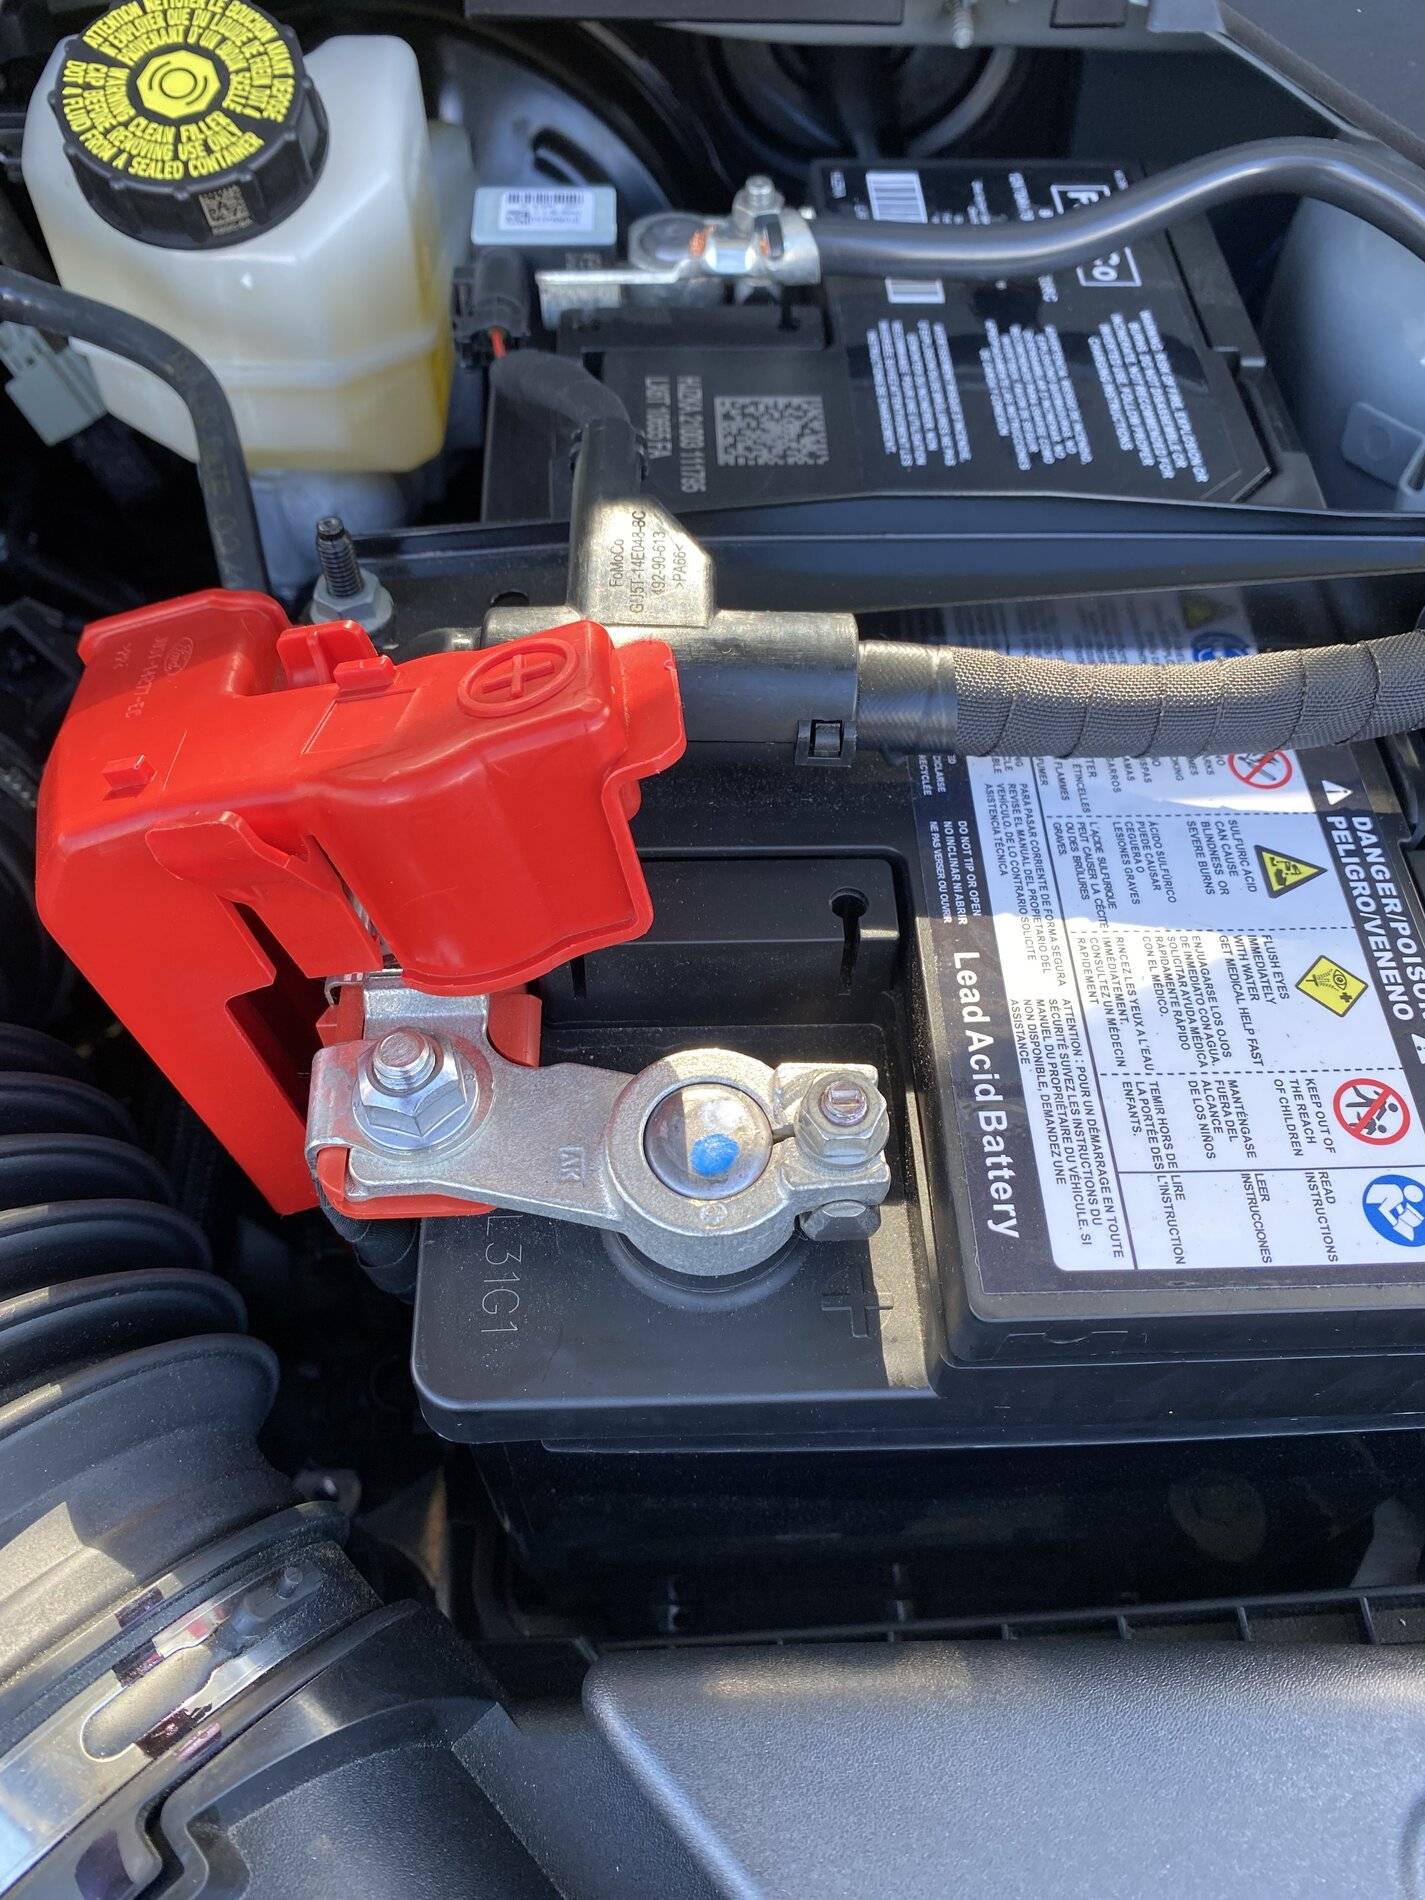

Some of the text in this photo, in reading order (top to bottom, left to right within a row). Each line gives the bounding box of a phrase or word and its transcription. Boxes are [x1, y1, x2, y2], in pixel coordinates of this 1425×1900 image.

[62, 60, 265, 180] DOT 4 FLUID FROM A SEALED CONTAINER
[83, 63, 244, 161] CAP BEFORE REMOVING USE ONLY
[104, 66, 230, 143] WARNING CLEAN FILLER
[609, 538, 624, 587] FoMoCo
[652, 531, 666, 595] 492-90-613
[1053, 761, 1070, 800] FLAMMES
[942, 820, 968, 925] NO INCLINAR NI ABRIR
[956, 820, 982, 916] DO NOT TIP OR OPEN
[1112, 821, 1141, 905] LESIONES GRAVES
[1123, 821, 1143, 864] CEGUERA
[1135, 820, 1161, 890] PUEDE CAUSAR
[1185, 820, 1216, 894] SEVERE BURNS
[1199, 821, 1230, 895] BLINDNESS OR
[1213, 820, 1239, 877] CAN CAUSE
[1227, 819, 1258, 892] SULFURIC ACID
[1114, 936, 1131, 973] RINCEZ
[1326, 815, 1414, 1021] PELIGRO/VENENO
[1075, 937, 1099, 1005] RAPIDEMENT
[1088, 937, 1127, 1067] CONSULTEZ UN MÉDECIN
[1100, 936, 1131, 1024] IMMÉDIATEMENT.
[1123, 976, 1137, 996] LES
[1141, 935, 1171, 1017] CON EL MÉDICO.
[1166, 935, 1211, 1068] SOLICITAR AYUDA MÉDICA
[1178, 935, 1221, 1066] DE INMEDIATO CON AGUA.
[1191, 935, 1232, 1057] ENJUAGARSE LOS OJOS
[1217, 934, 1264, 1066] GET MEDICAL HELP FAST
[1231, 934, 1261, 1001] WITH WATER
[1246, 934, 1277, 1004] IMMEDIATELY
[1261, 934, 1290, 999] FLUSH EYES
[1009, 998, 1030, 1064] ASSISTANCE
[1034, 998, 1053, 1041] MANUEL
[1128, 998, 1144, 1026] YEUX
[1043, 1044, 1056, 1059] DU
[1137, 1038, 1155, 1071] L'EAU
[952, 951, 1026, 1239] Lead Acid Battery
[1022, 998, 1066, 1184] NON DISPONIBLE, DEMANDEZ UNE
[1046, 1061, 1074, 1143] PROPRIÉTAIRE
[1047, 998, 1103, 1225] SÉCURITÉ SUIVEZ LES INSTRUCTIONS DU
[1061, 998, 1124, 1258] ATTENTION POUR UN DÉMARRAGE EN TOUTE
[1121, 1081, 1143, 1136] ENFANTS.
[1134, 1080, 1165, 1170] LA PORTÉE DES
[1148, 1081, 1178, 1169] TEMIR HORS DE
[1187, 1080, 1219, 1159] DE LOS NIÑOS
[1200, 1079, 1224, 1134] ALCANCE
[1213, 1079, 1239, 1142] FUERA DEL
[1226, 1079, 1259, 1158] MANTÉNGASE
[1272, 1079, 1304, 1156] OF CHILDREN
[1288, 1079, 1317, 1144] THE REACH
[1304, 1078, 1336, 1153] KEEP OUT OF
[1063, 1146, 1076, 1163] DU
[1169, 1174, 1186, 1200] LIRE
[1253, 1172, 1271, 1202] LEER
[1317, 1171, 1337, 1204] READ
[1079, 1233, 1092, 1245] SI
[1155, 1174, 1187, 1265] L'INSTRUCTION
[1239, 1172, 1273, 1263] INSTRUCCIONES
[1303, 1171, 1339, 1262] INSTRUCTIONS
